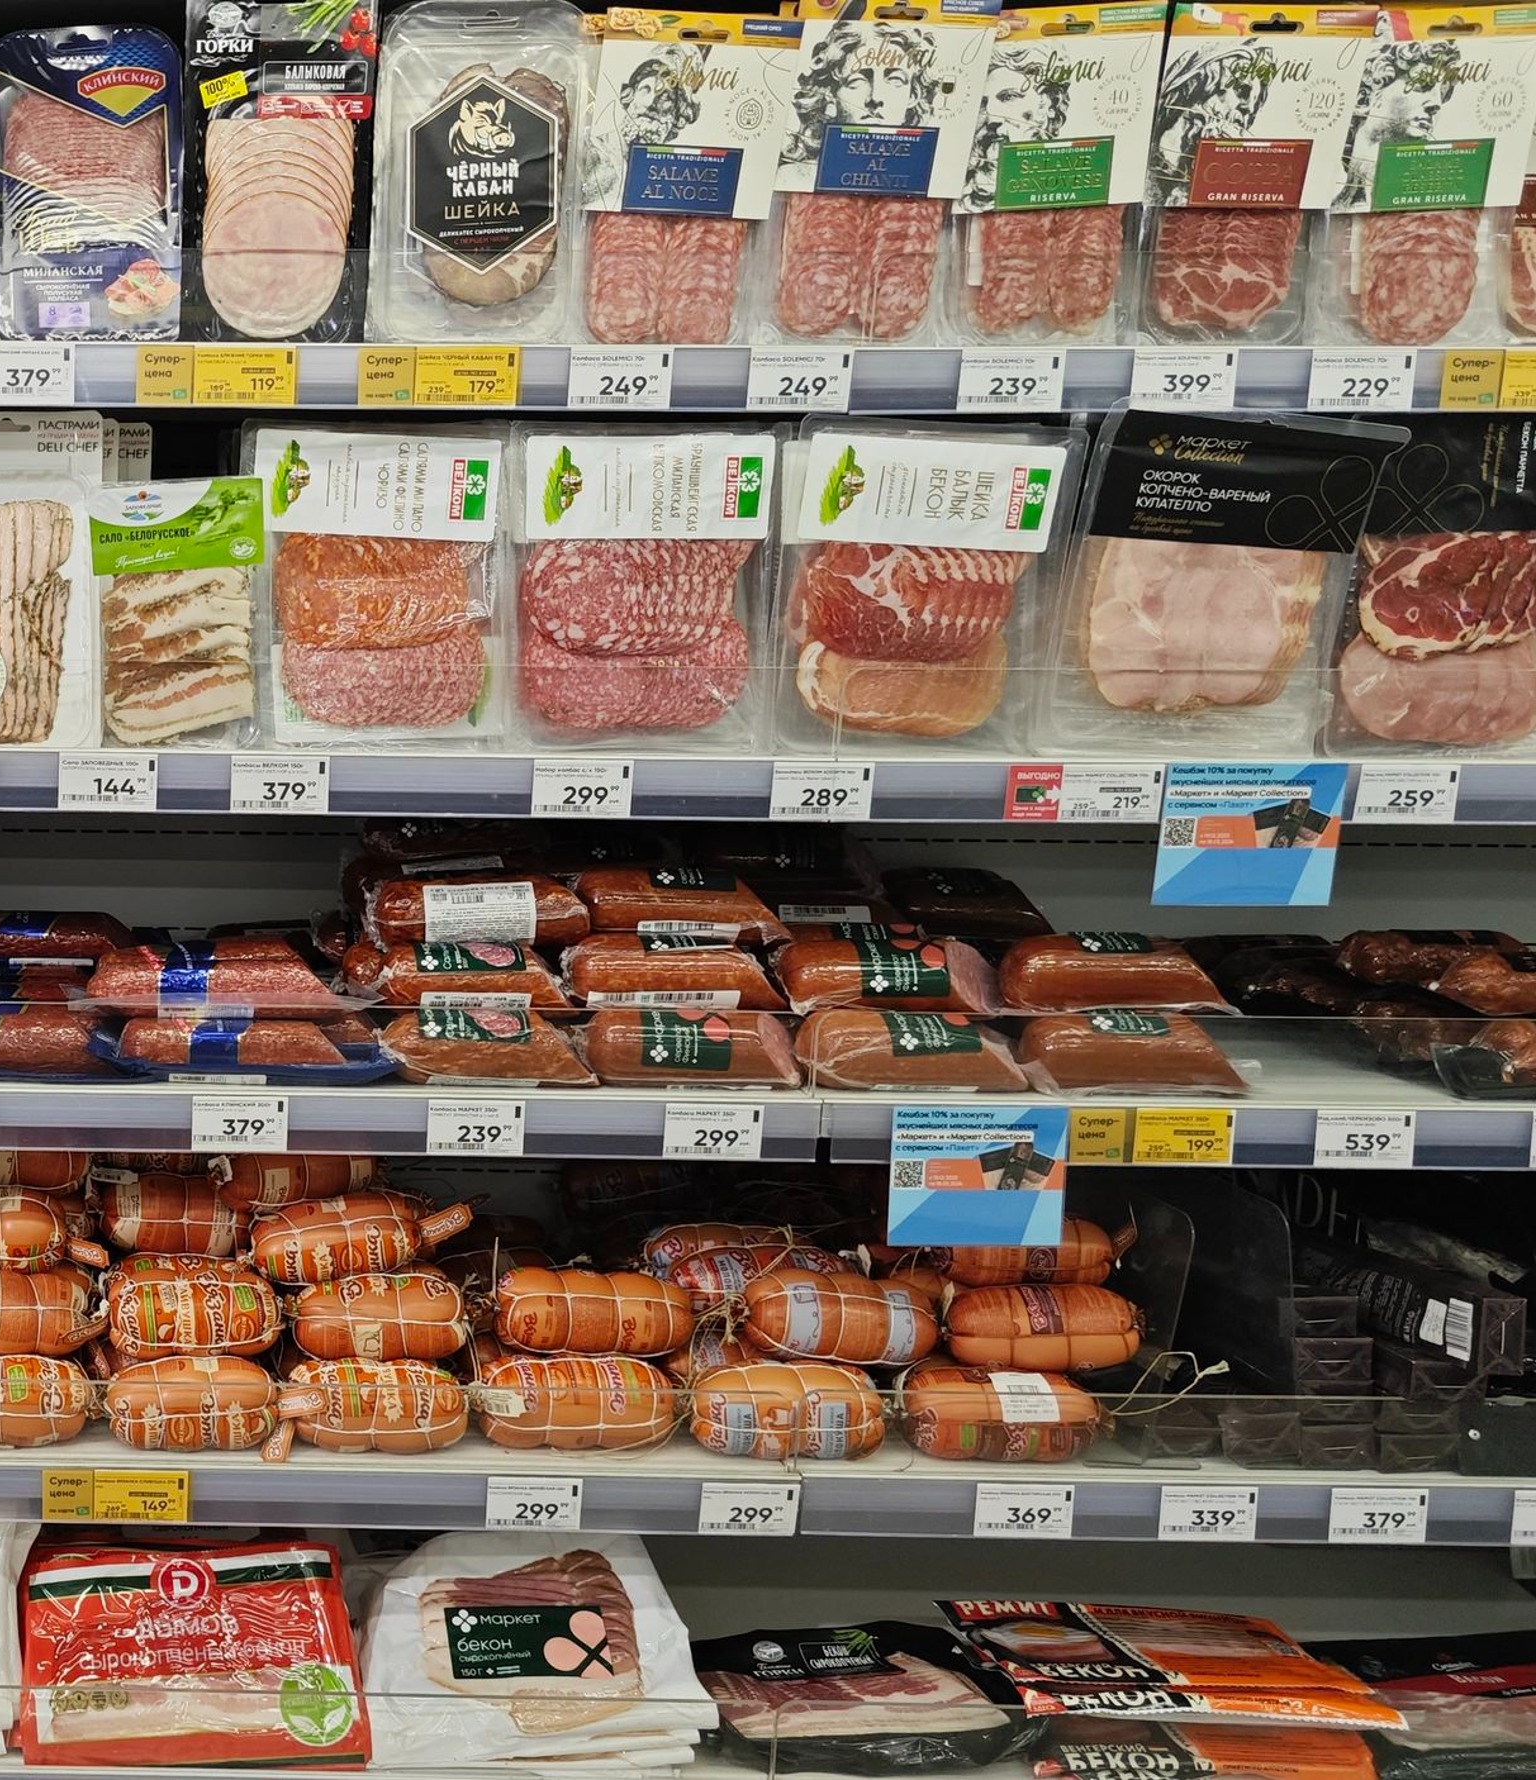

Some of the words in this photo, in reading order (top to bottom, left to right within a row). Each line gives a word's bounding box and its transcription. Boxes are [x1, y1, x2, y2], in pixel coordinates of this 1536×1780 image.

[195, 38, 253, 55] ГОРКИ
[284, 63, 346, 80] БАЛЫКОВАЯ
[83, 72, 161, 93] КЛИНСКИЙ
[204, 78, 235, 95] 100%
[648, 165, 718, 182] SALAME
[867, 159, 887, 172] AL
[452, 177, 513, 197] КАБАН
[641, 182, 669, 200] AL
[672, 184, 718, 202] NOCE
[1029, 192, 1076, 202] RISERVA
[1207, 192, 1238, 201] GRAN
[1240, 193, 1284, 202] RISERVA
[444, 200, 520, 219] ШЕЙКА
[23, 264, 103, 279] МИЛАНСКАЯ
[1453, 357, 1496, 369] Супер-
[251, 377, 274, 391] 119
[469, 380, 495, 393] 179
[600, 375, 647, 396] 249
[1163, 374, 1211, 393] 399
[1451, 372, 1480, 384] цена
[1342, 377, 1389, 398] 229
[38, 420, 101, 431] ПАСТРАМИ
[37, 442, 63, 453] DELI
[65, 442, 99, 453] CHEF
[1177, 435, 1252, 450] маркет
[1143, 470, 1201, 484] ОКОРОК
[926, 466, 943, 519] БЕКОН
[971, 471, 995, 523] ШЕЙКА
[1139, 482, 1270, 503] КОПЧЕНО-ВАРЕНЫЙ
[1135, 495, 1212, 513] КУПАТЕЛЛО
[99, 533, 123, 544] САЛО
[125, 528, 195, 542] «БЕЛОРУССКОЕ»
[1017, 771, 1061, 781] ВЫГОДНО
[93, 777, 135, 795] 144
[801, 788, 847, 807] 289
[1113, 795, 1140, 810] 219
[1388, 789, 1435, 807] 259
[458, 1125, 502, 1143] 239
[694, 1129, 739, 1148] 299
[1346, 1134, 1390, 1152] 539
[141, 1499, 168, 1513] 149
[514, 1502, 558, 1519] 299
[1007, 1507, 1050, 1524] 369
[1191, 1509, 1235, 1526] 339
[1363, 1512, 1406, 1529] 379
[480, 1614, 540, 1625] маркет
[457, 1636, 513, 1651] бекон
